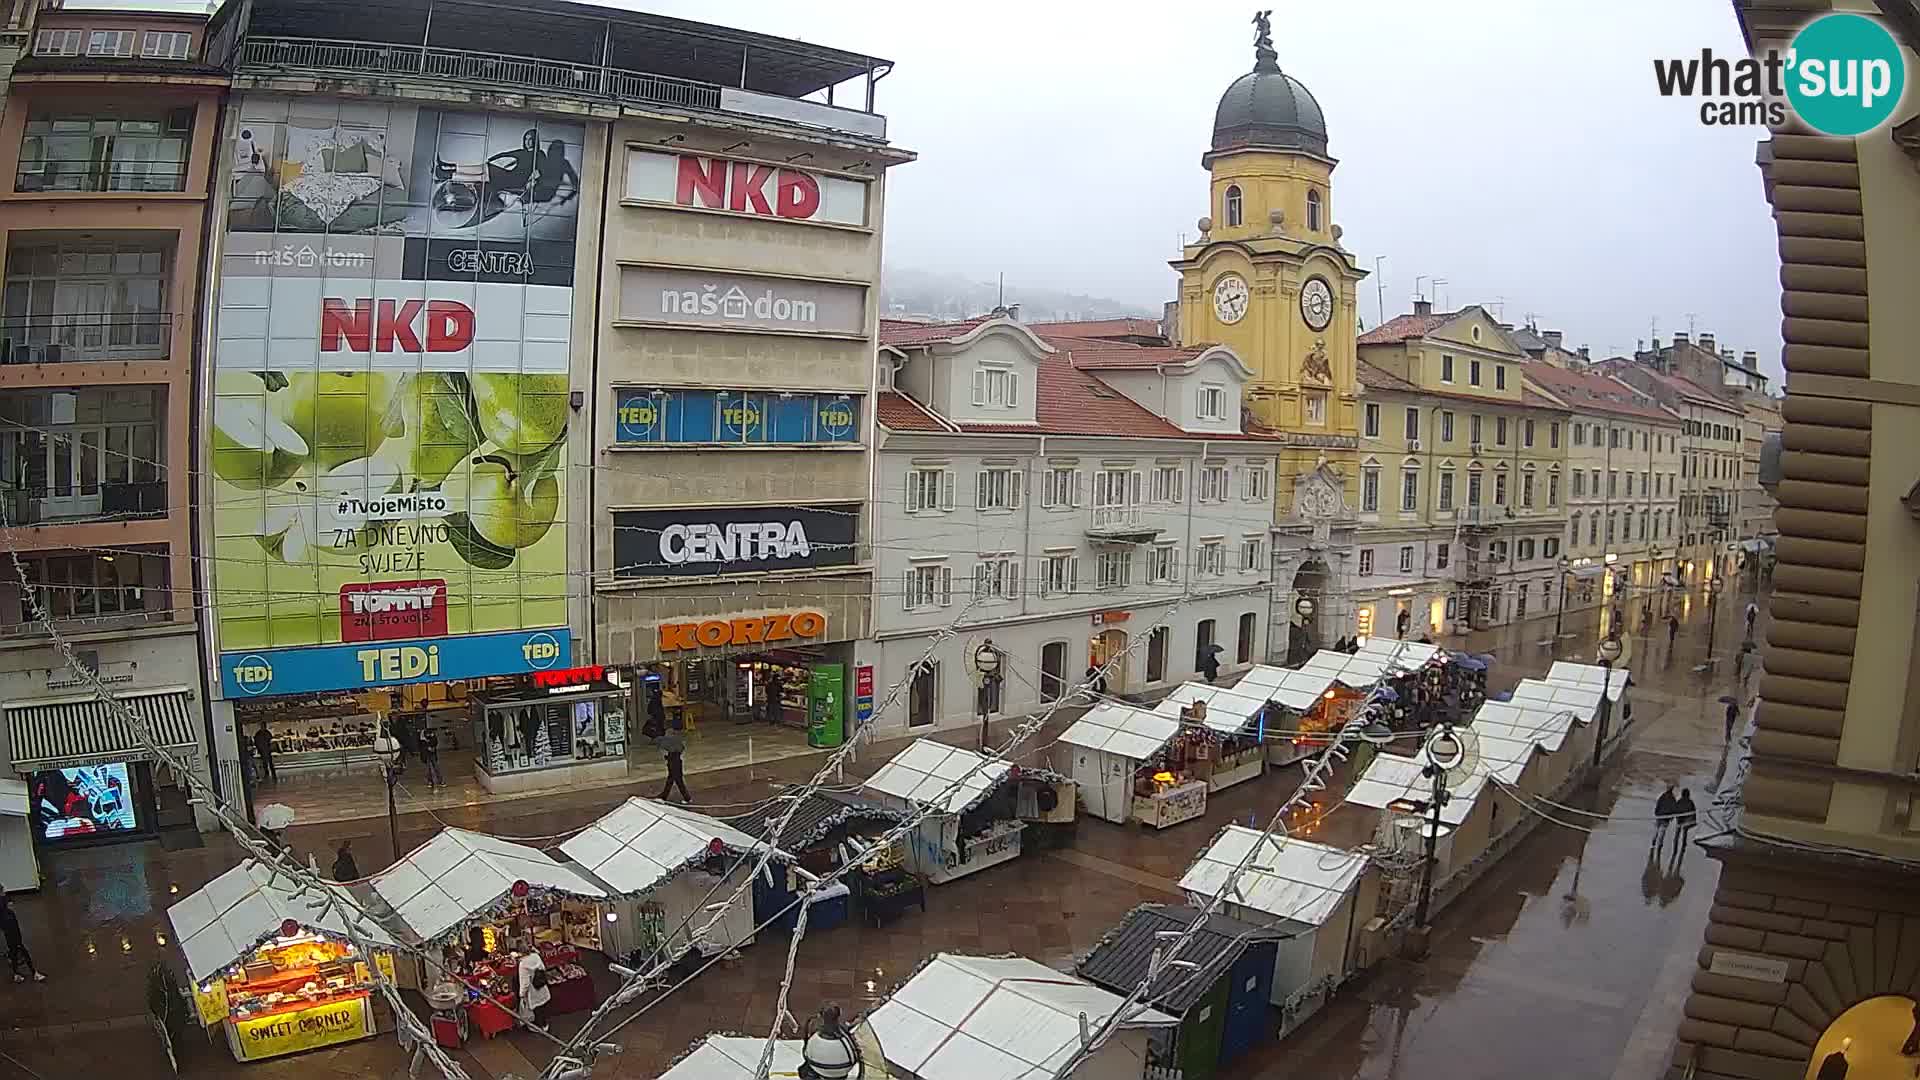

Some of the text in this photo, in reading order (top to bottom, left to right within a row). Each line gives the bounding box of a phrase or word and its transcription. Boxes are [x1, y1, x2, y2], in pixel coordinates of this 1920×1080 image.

[676, 155, 820, 218] NKD
[255, 245, 365, 267] naš dom
[447, 249, 535, 275] CENTRA
[662, 284, 816, 322] naš dom
[320, 297, 477, 352] NKD
[618, 408, 657, 425] TEDi
[723, 408, 760, 425] TEDi
[819, 410, 853, 426] TEDi
[338, 497, 446, 516] #TvojeMisto
[333, 523, 450, 548] ZA DNEVNO
[659, 521, 810, 563] CENTRA
[359, 547, 425, 575] SVJEŽE
[348, 585, 438, 614] TOMMY
[658, 612, 826, 652] KORZO
[357, 645, 440, 682] TEDi
[522, 643, 560, 660] TEDi
[233, 666, 272, 683] TEDi
[249, 1021, 292, 1041] SWEET
